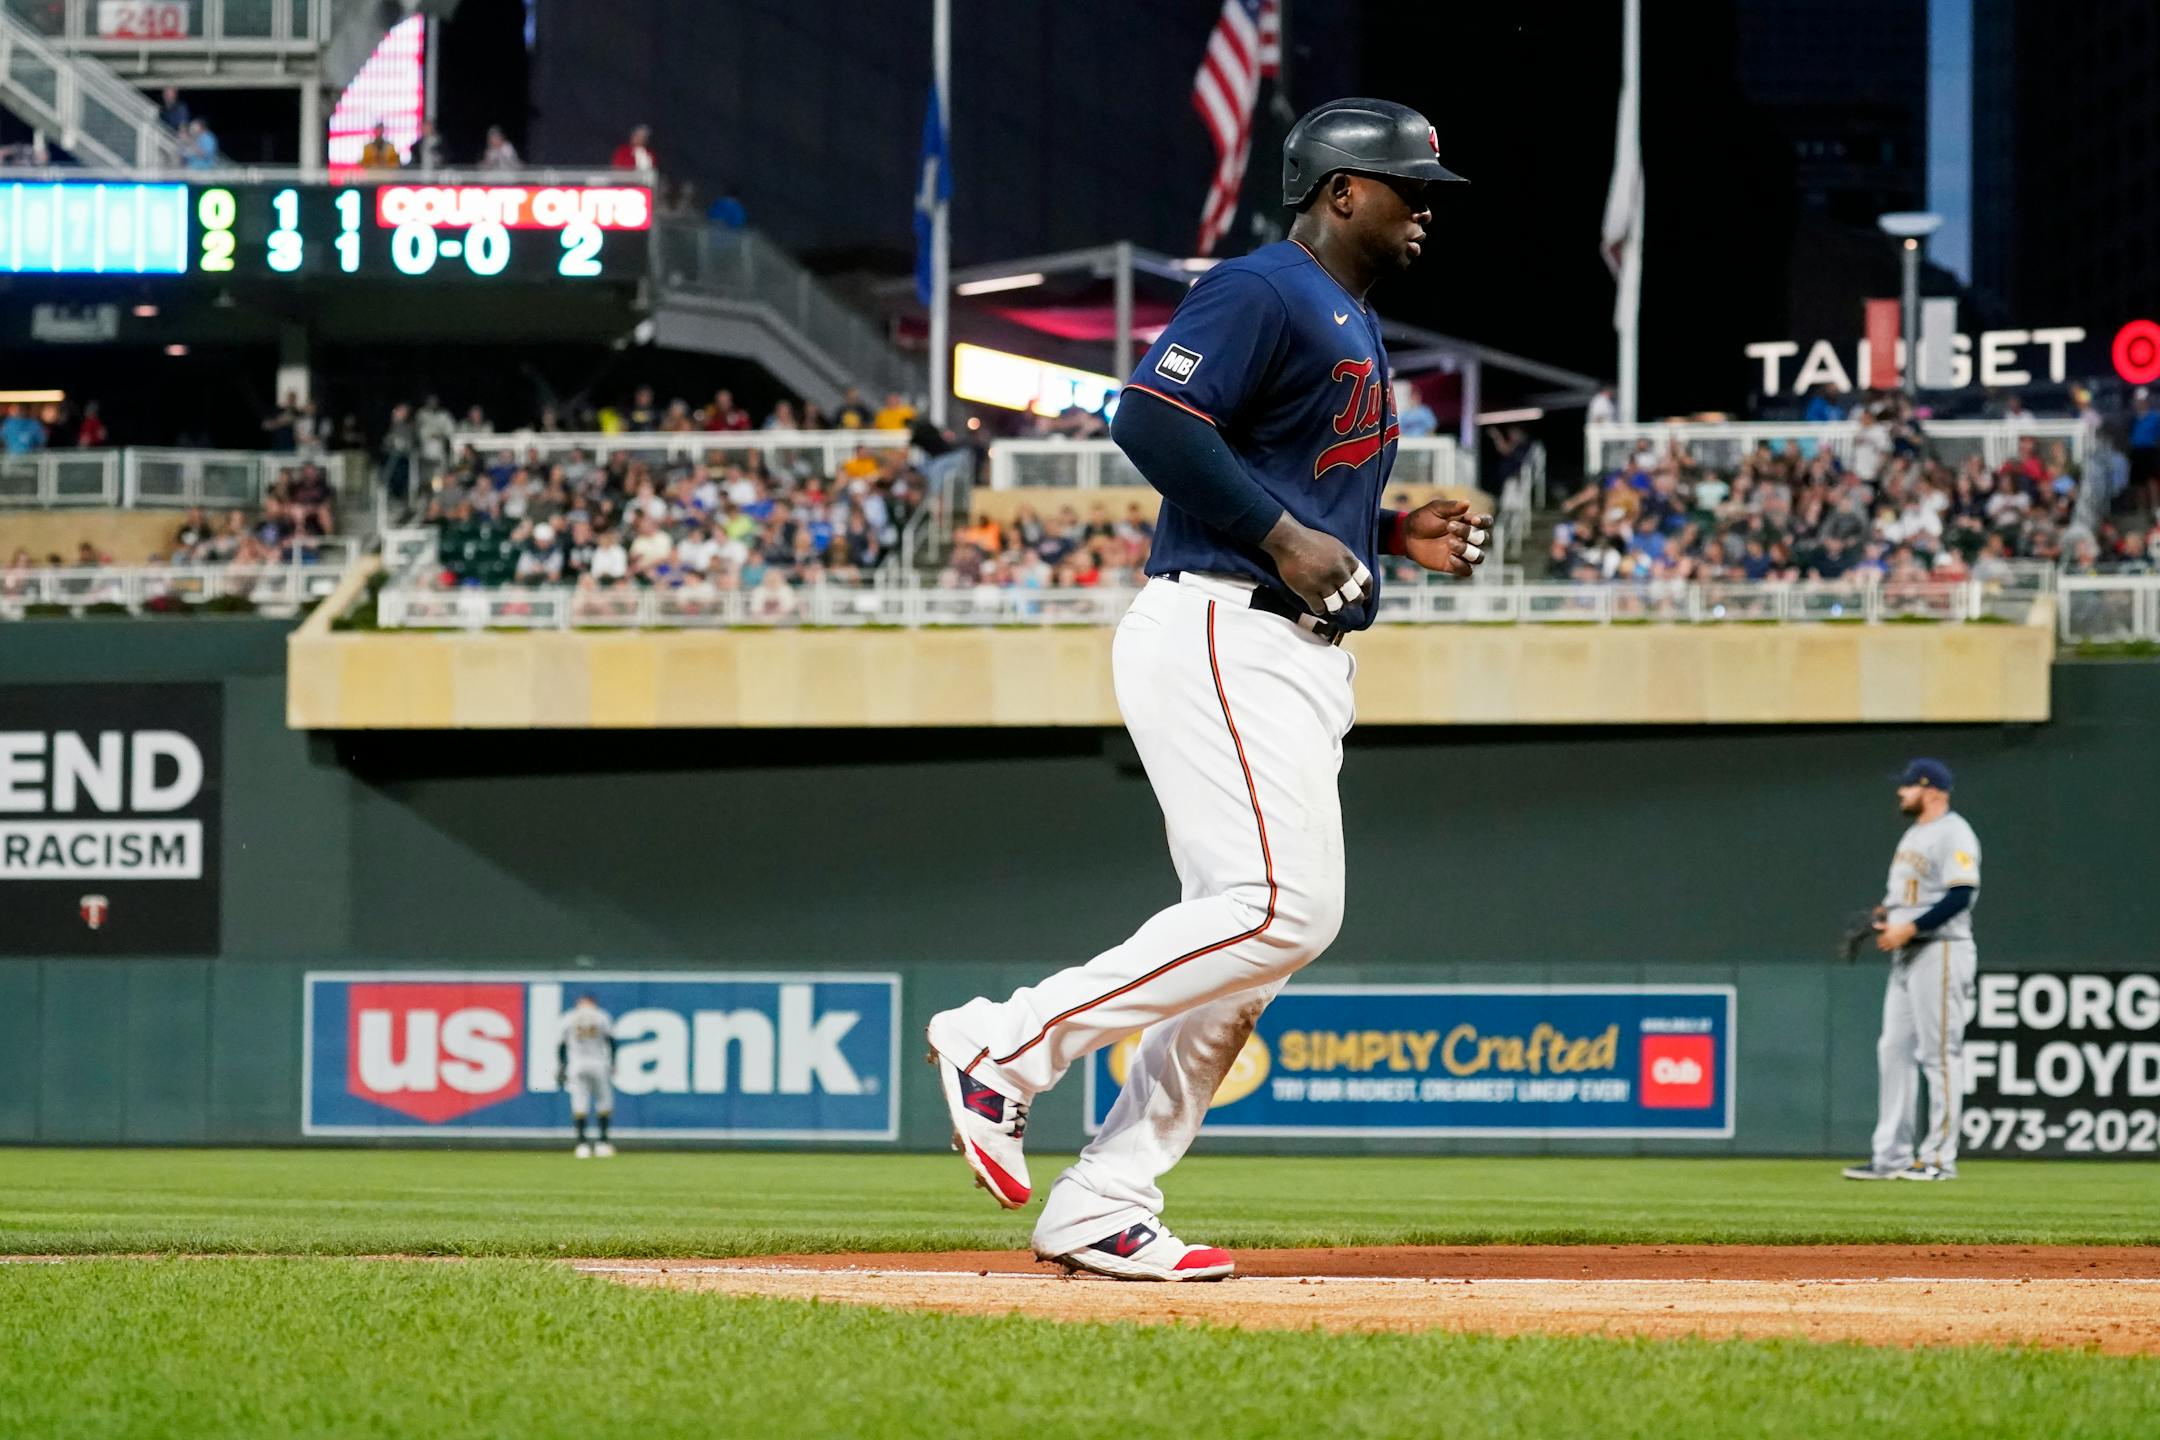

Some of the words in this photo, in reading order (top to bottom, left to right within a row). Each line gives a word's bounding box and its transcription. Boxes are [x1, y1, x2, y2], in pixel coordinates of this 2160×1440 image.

[199, 188, 236, 230] 0
[273, 189, 298, 231] 1
[335, 190, 361, 231] 1
[381, 187, 528, 226] COUNT
[532, 188, 648, 227] OUTS
[200, 229, 235, 272] 2
[267, 230, 303, 272] 3
[334, 230, 361, 273] 1
[391, 222, 511, 276] 0-0
[558, 222, 604, 277] 2
[1162, 351, 1194, 375] MB
[0, 730, 204, 813] END
[5, 833, 186, 868] RACISM
[1962, 974, 2160, 1030] EORG
[1278, 1030, 1441, 1073] SIMPLY
[1442, 1023, 1620, 1076] Crafted
[1962, 1040, 2160, 1098] FLOYD
[1962, 1107, 2160, 1152] 973-202
